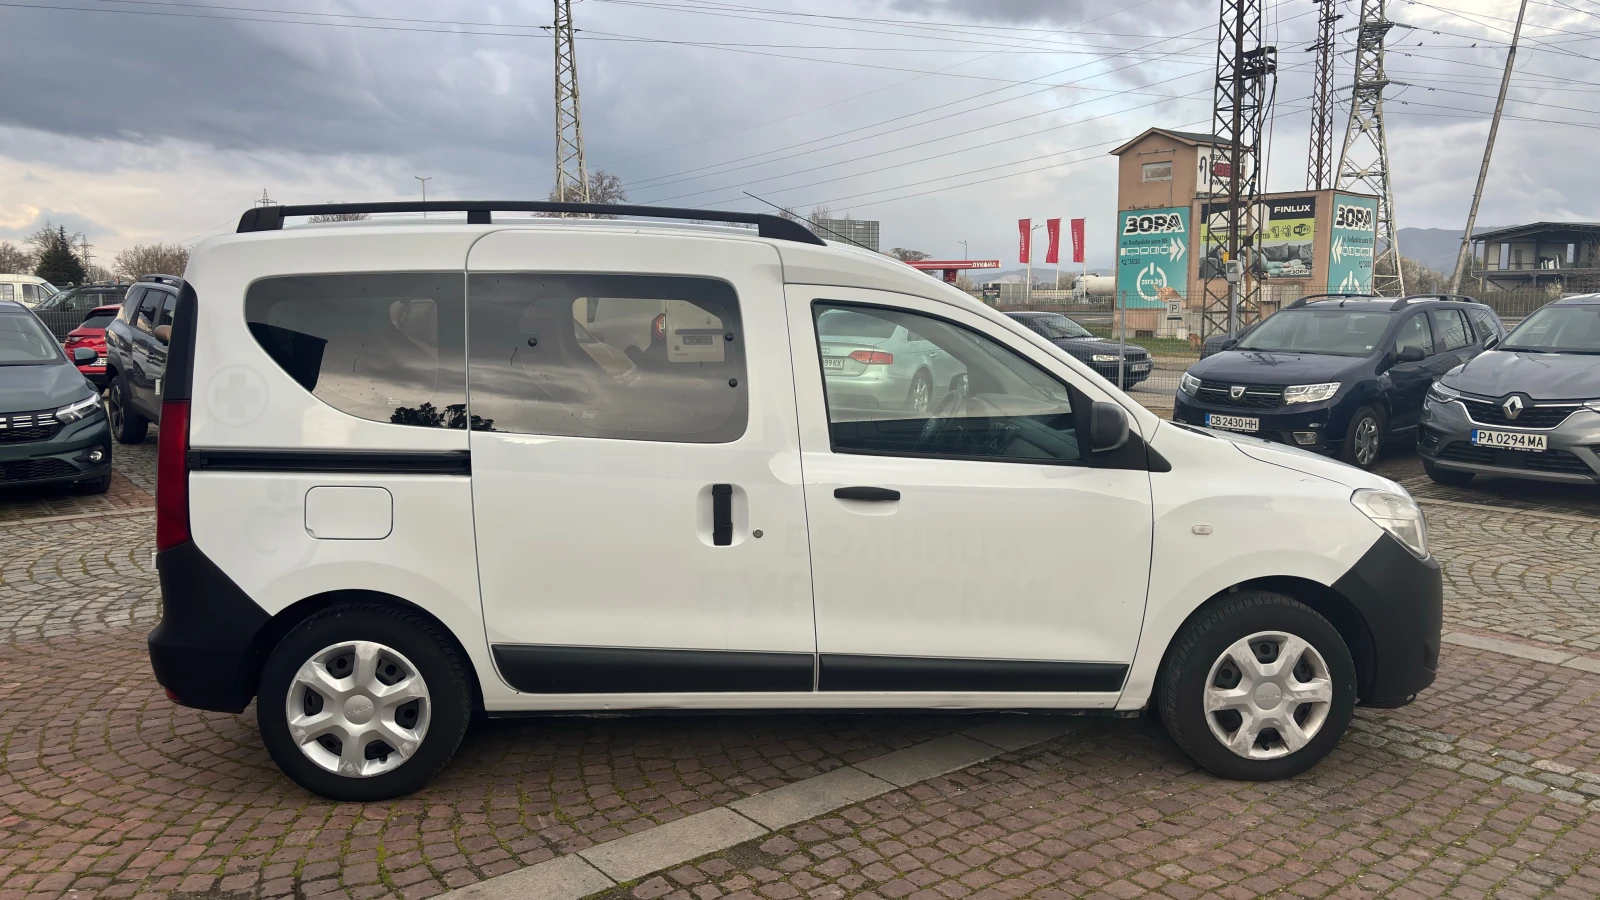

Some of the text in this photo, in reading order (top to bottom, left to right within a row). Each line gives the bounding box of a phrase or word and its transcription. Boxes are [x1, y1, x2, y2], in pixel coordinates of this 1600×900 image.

[1274, 204, 1311, 214] FINLUX
[1334, 203, 1374, 231] ЗОРА
[1123, 213, 1185, 235] ЗОРА
[1222, 416, 1244, 428] 2430
[1244, 418, 1257, 430] HH
[1478, 432, 1494, 444] PA
[1496, 433, 1526, 446] 0294
[1528, 435, 1544, 448] MA
